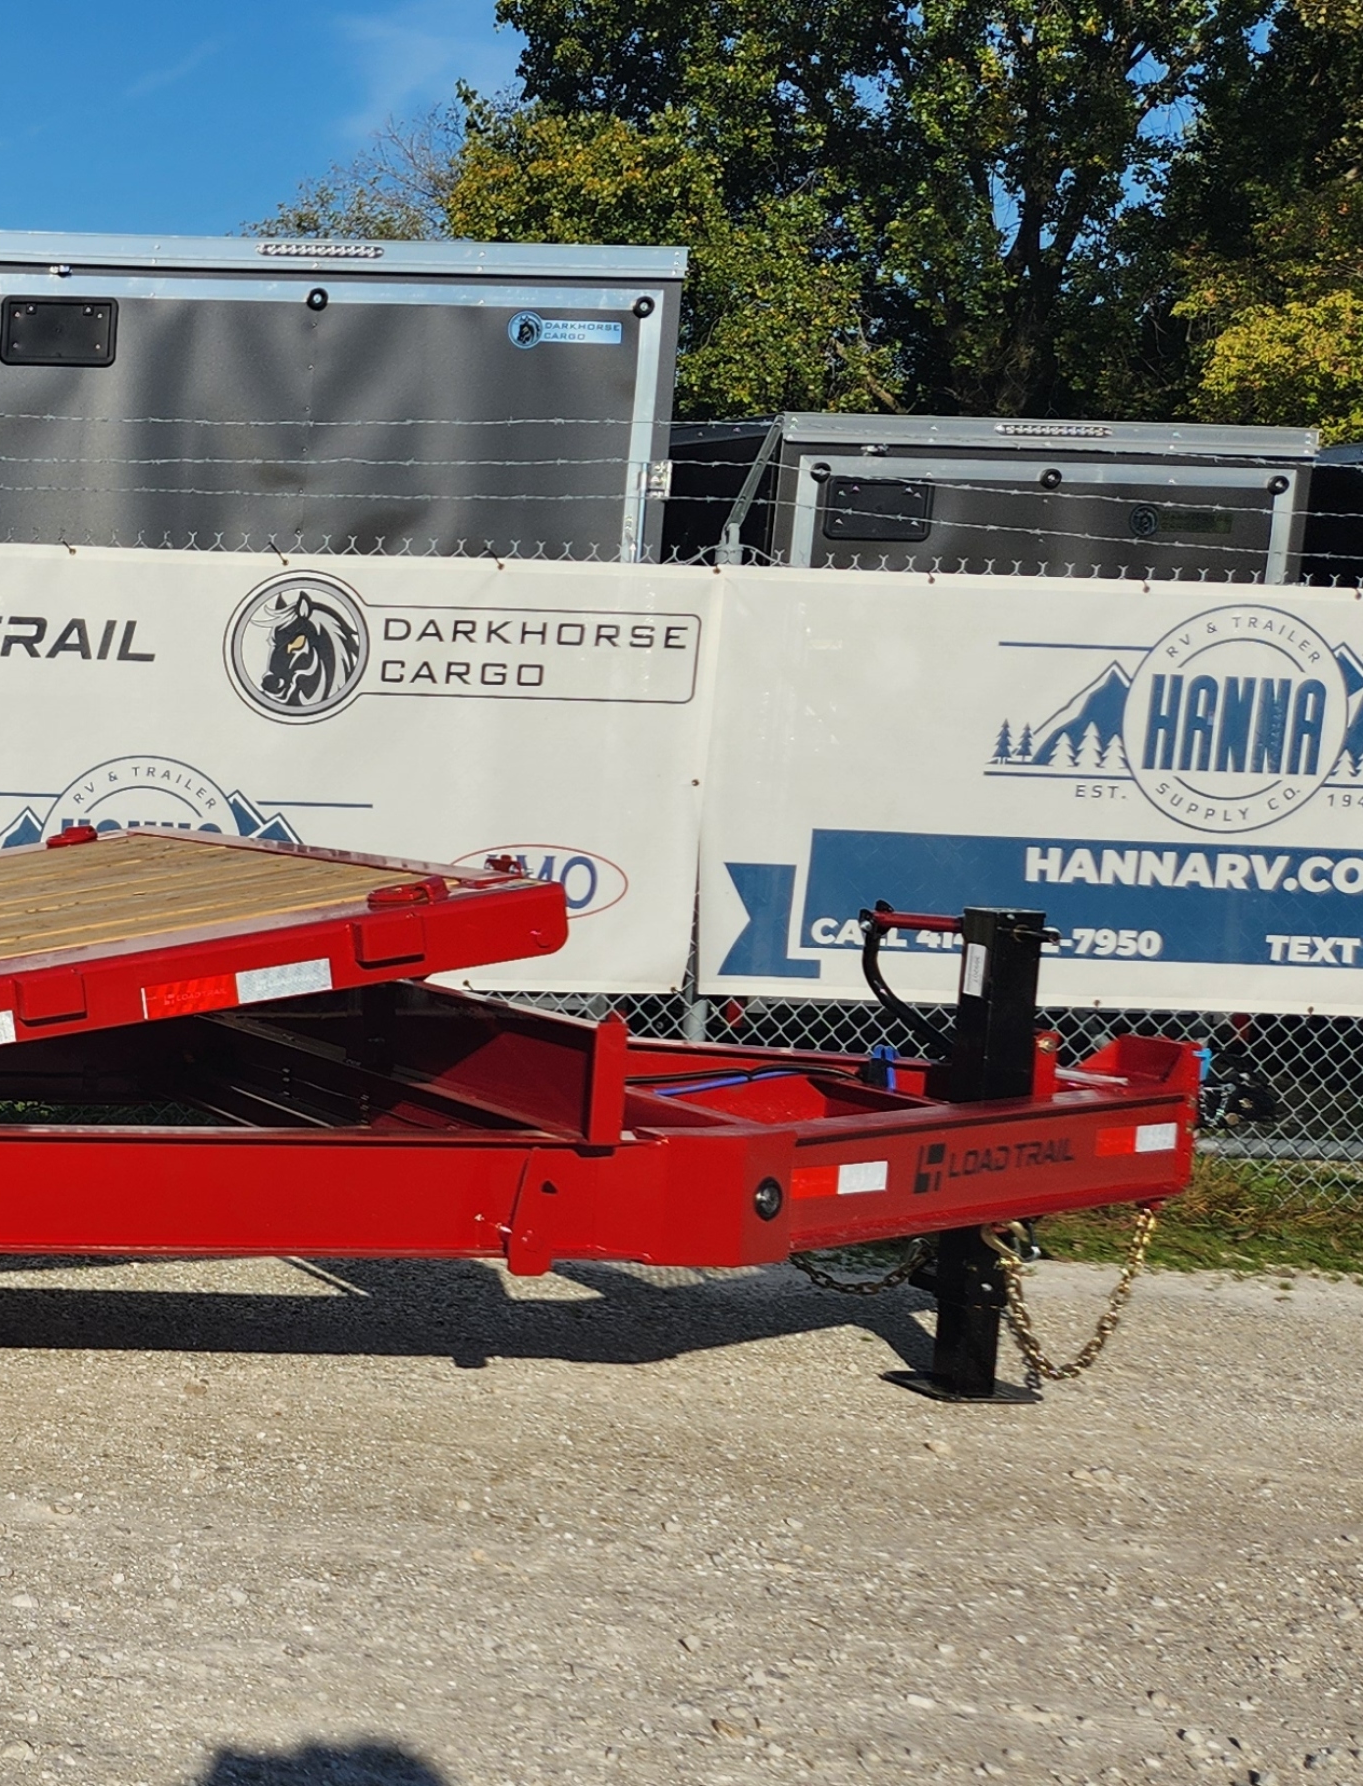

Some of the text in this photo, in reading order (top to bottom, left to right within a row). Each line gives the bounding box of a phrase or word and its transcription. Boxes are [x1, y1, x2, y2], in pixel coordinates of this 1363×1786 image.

[383, 617, 689, 650] DARKHORSE
[1166, 635, 1192, 660] RV
[1232, 616, 1321, 665] TRAILER
[380, 660, 545, 687] CARGO
[1141, 673, 1328, 776] HANNA
[72, 781, 95, 805] RV
[131, 766, 217, 810] TRAILER
[1075, 784, 1127, 800] EST.
[1154, 781, 1302, 823] SUPPLY CO.
[1266, 934, 1361, 964] TEXT
[948, 1137, 1075, 1178] LOAD TRAIL
